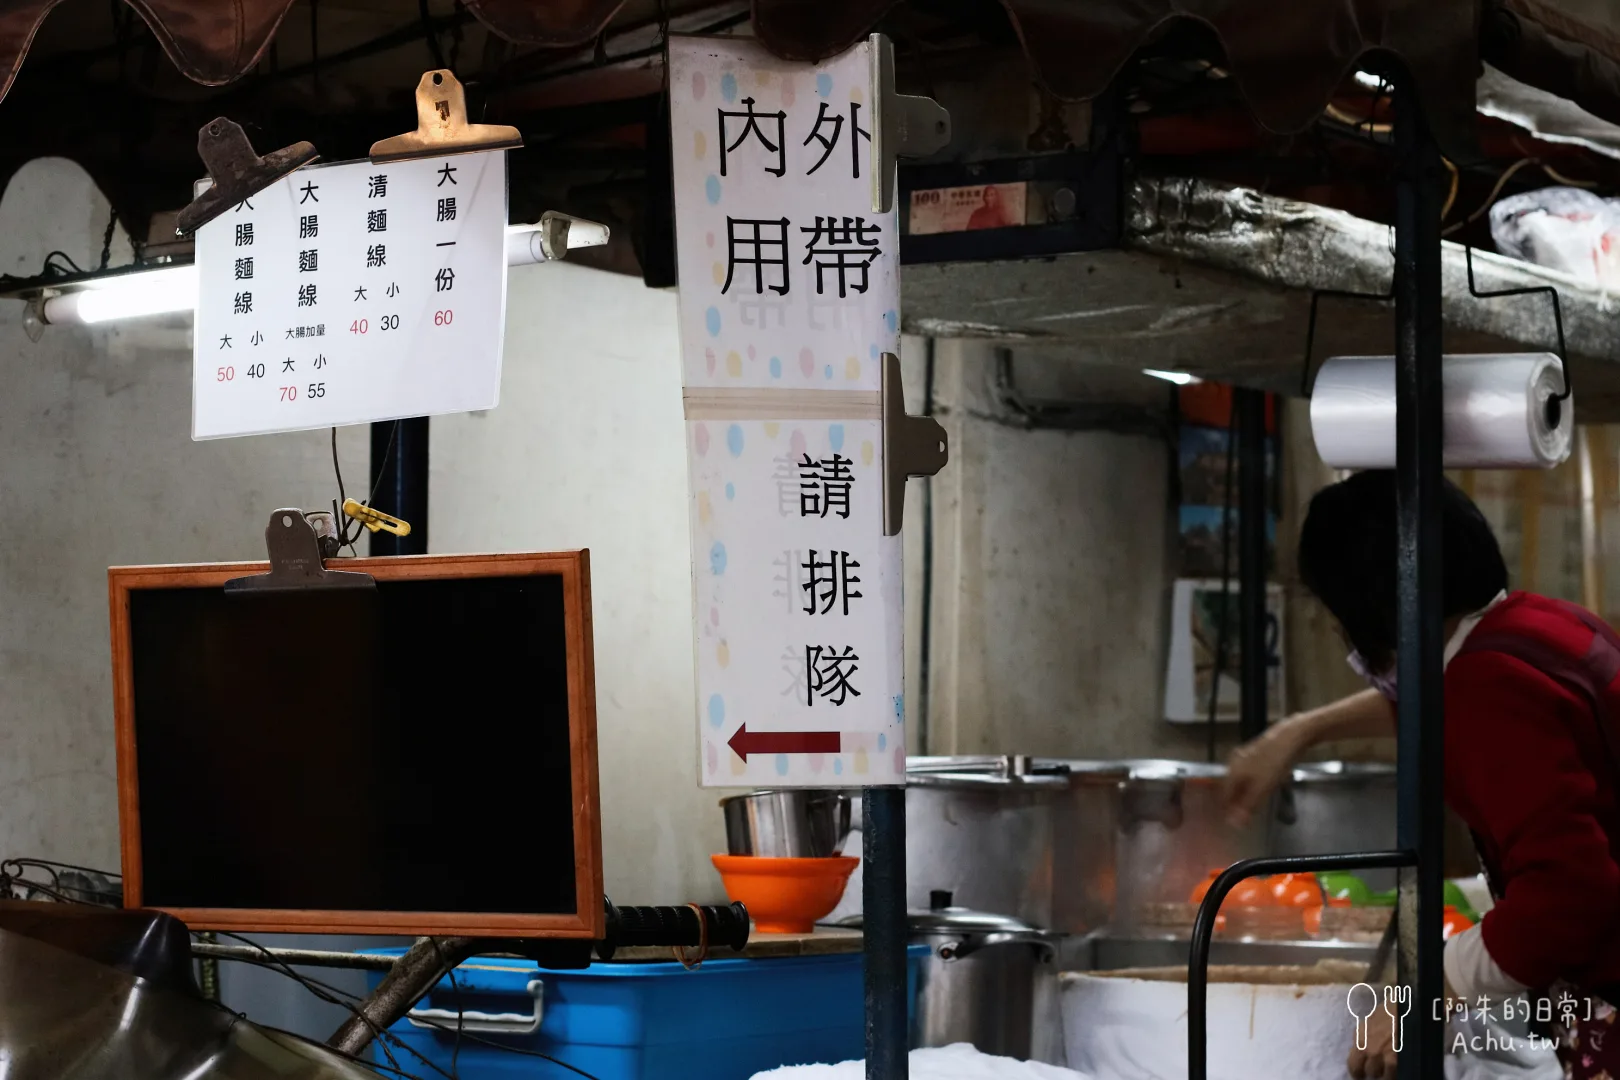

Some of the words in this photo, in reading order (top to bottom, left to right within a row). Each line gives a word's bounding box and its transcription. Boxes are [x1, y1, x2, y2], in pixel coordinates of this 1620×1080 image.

[718, 97, 790, 296] 內用
[800, 102, 884, 298] 外帶
[915, 191, 940, 205] 100
[366, 174, 388, 268] 清麵線
[435, 162, 458, 292] 大腸一份
[297, 181, 320, 307] 大腸麵線
[353, 285, 368, 302] 大
[386, 281, 400, 298] 小
[349, 318, 369, 335] 40
[380, 314, 400, 331] 30
[434, 310, 453, 326] 60
[219, 333, 233, 350] 大
[250, 330, 264, 347] 小
[285, 323, 326, 340] 大腸加量
[217, 366, 235, 382] 50
[247, 363, 265, 379] 40
[282, 356, 296, 373] 大
[313, 353, 327, 370] 小
[279, 386, 297, 402] 70
[307, 382, 326, 399] 55
[798, 453, 862, 706] 請排隊
